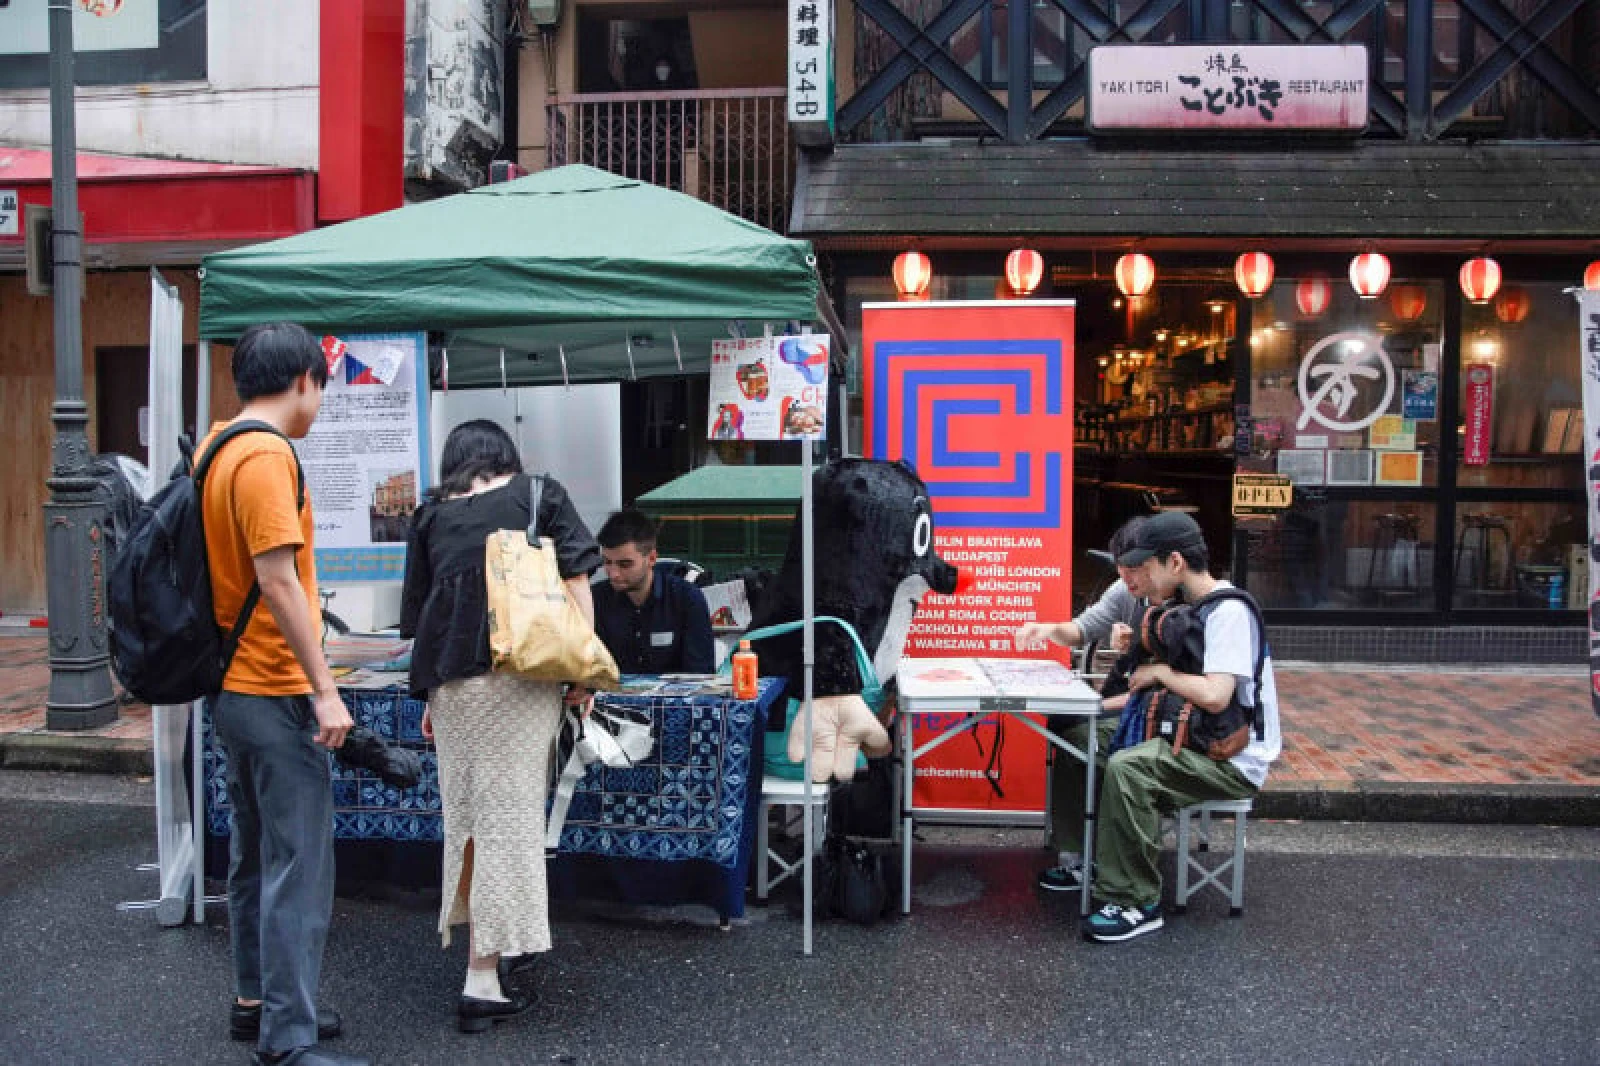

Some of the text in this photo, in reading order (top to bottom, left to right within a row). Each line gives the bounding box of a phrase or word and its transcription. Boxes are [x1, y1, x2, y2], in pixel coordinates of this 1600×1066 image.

[796, 3, 820, 47] 料理
[1100, 80, 1169, 94] YAKITORI
[1287, 79, 1365, 94] RESTAURANT
[1177, 74, 1283, 122] ことぶき
[967, 535, 1043, 549] BRATISLAVA
[943, 551, 1009, 563] BUDAPEST
[1008, 566, 1061, 577] LONDON
[976, 578, 1041, 593] MÜNCHEN
[927, 595, 1034, 607] NEW YORK PARIS
[948, 610, 986, 621] ROMA
[915, 639, 985, 651] WARSZAWA
